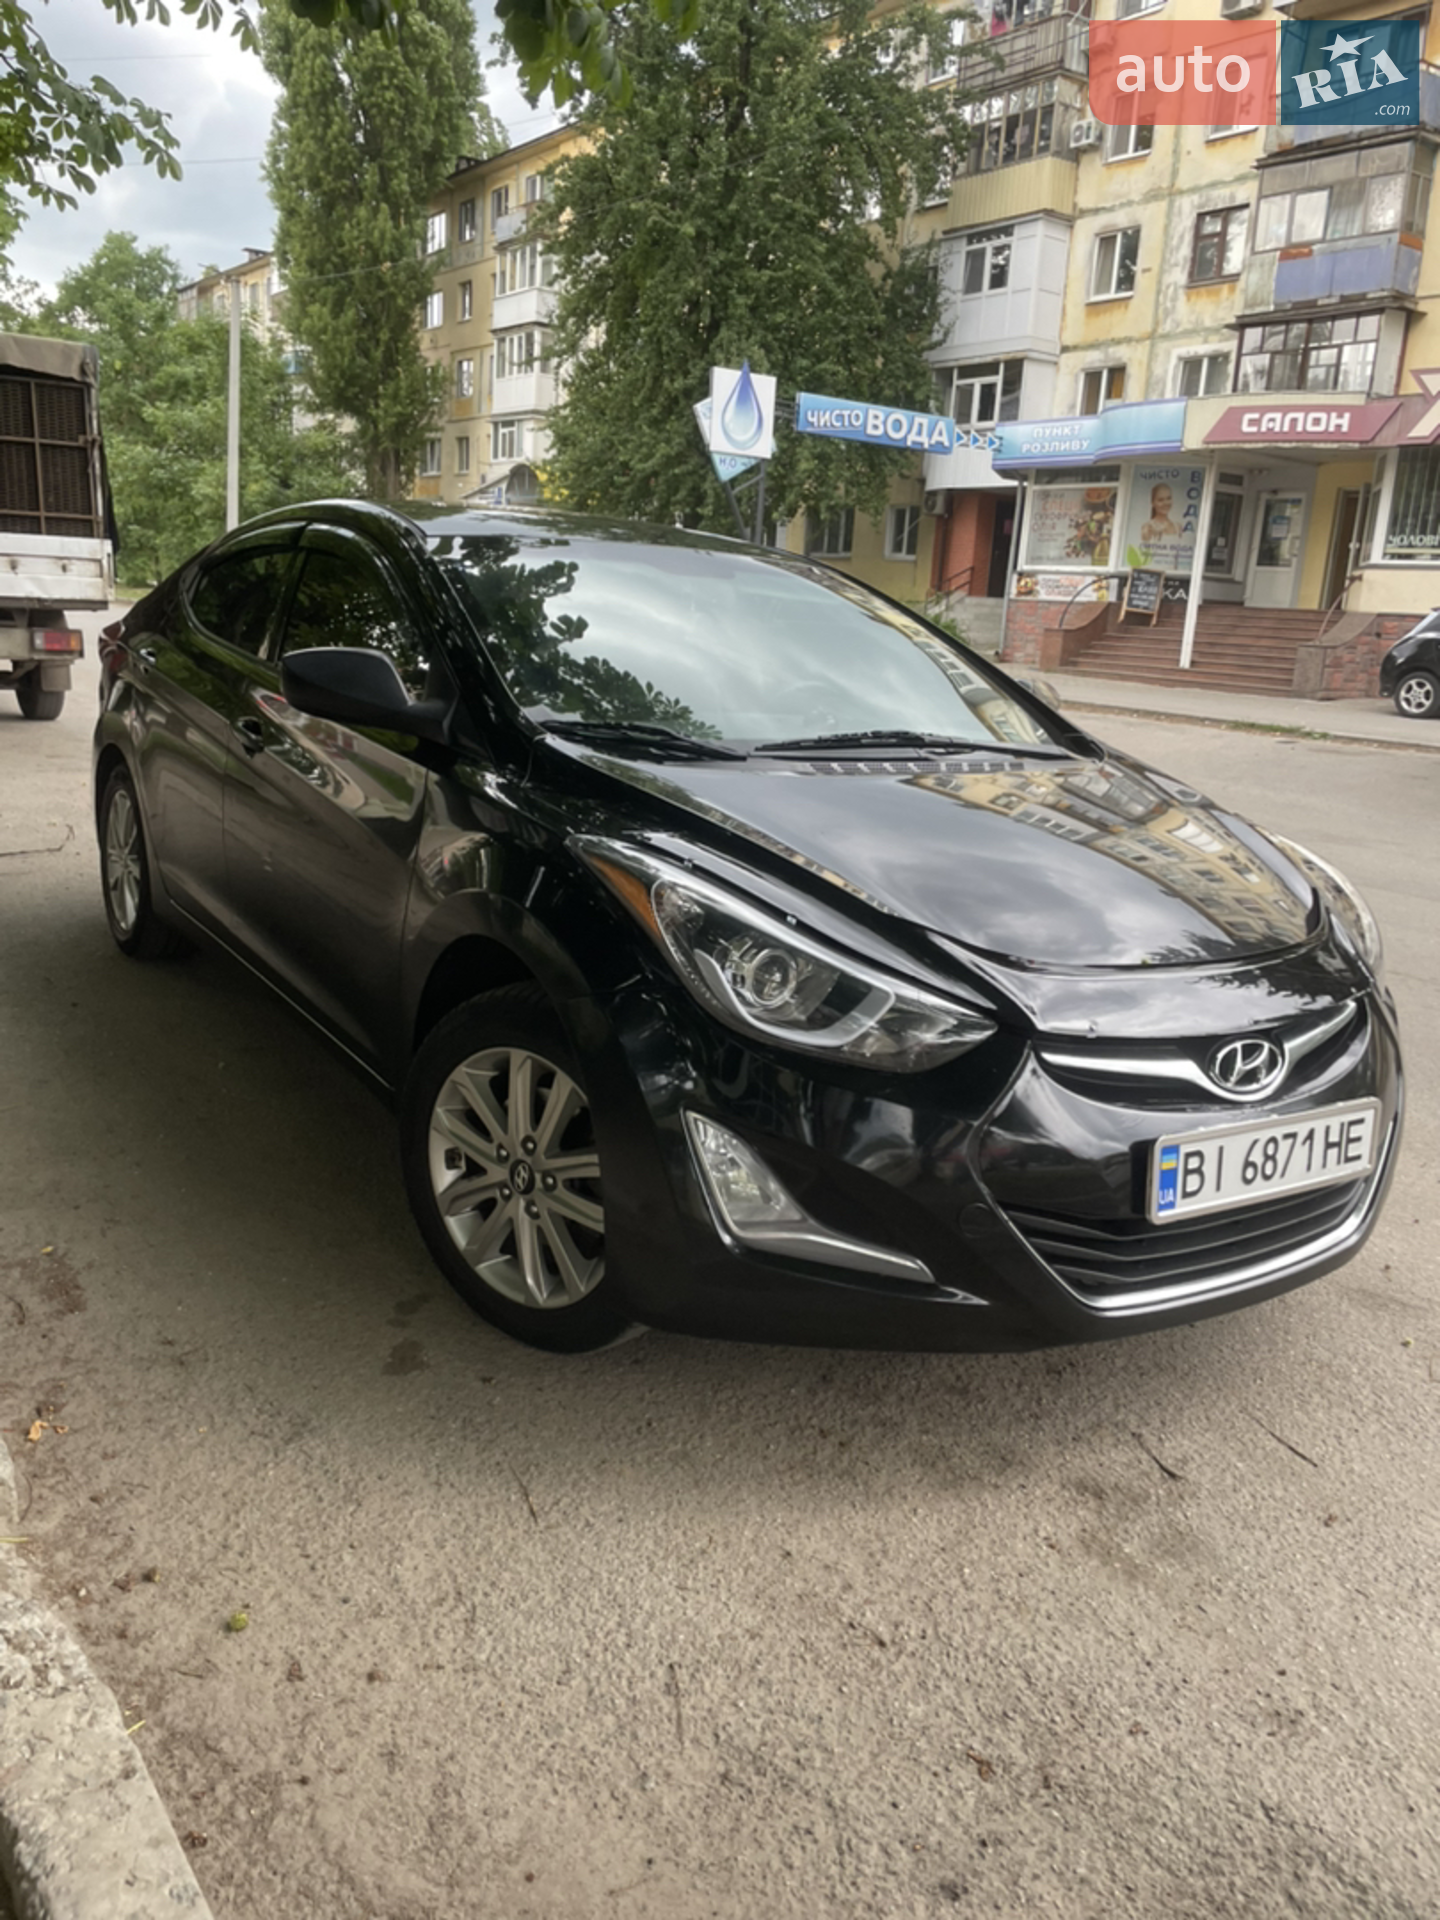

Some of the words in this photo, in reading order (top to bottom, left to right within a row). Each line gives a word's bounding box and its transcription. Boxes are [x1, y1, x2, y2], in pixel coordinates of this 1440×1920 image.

[806, 408, 863, 428] ЧИСТО
[865, 408, 950, 449] ВОДА
[1033, 424, 1082, 438] ПУНКТ
[1241, 412, 1351, 433] САЛОН
[1022, 439, 1090, 454] РОЗЛИВУ
[1140, 468, 1180, 480] ЧИСТО
[1182, 470, 1201, 533] ВОДА
[1158, 1187, 1175, 1205] UA
